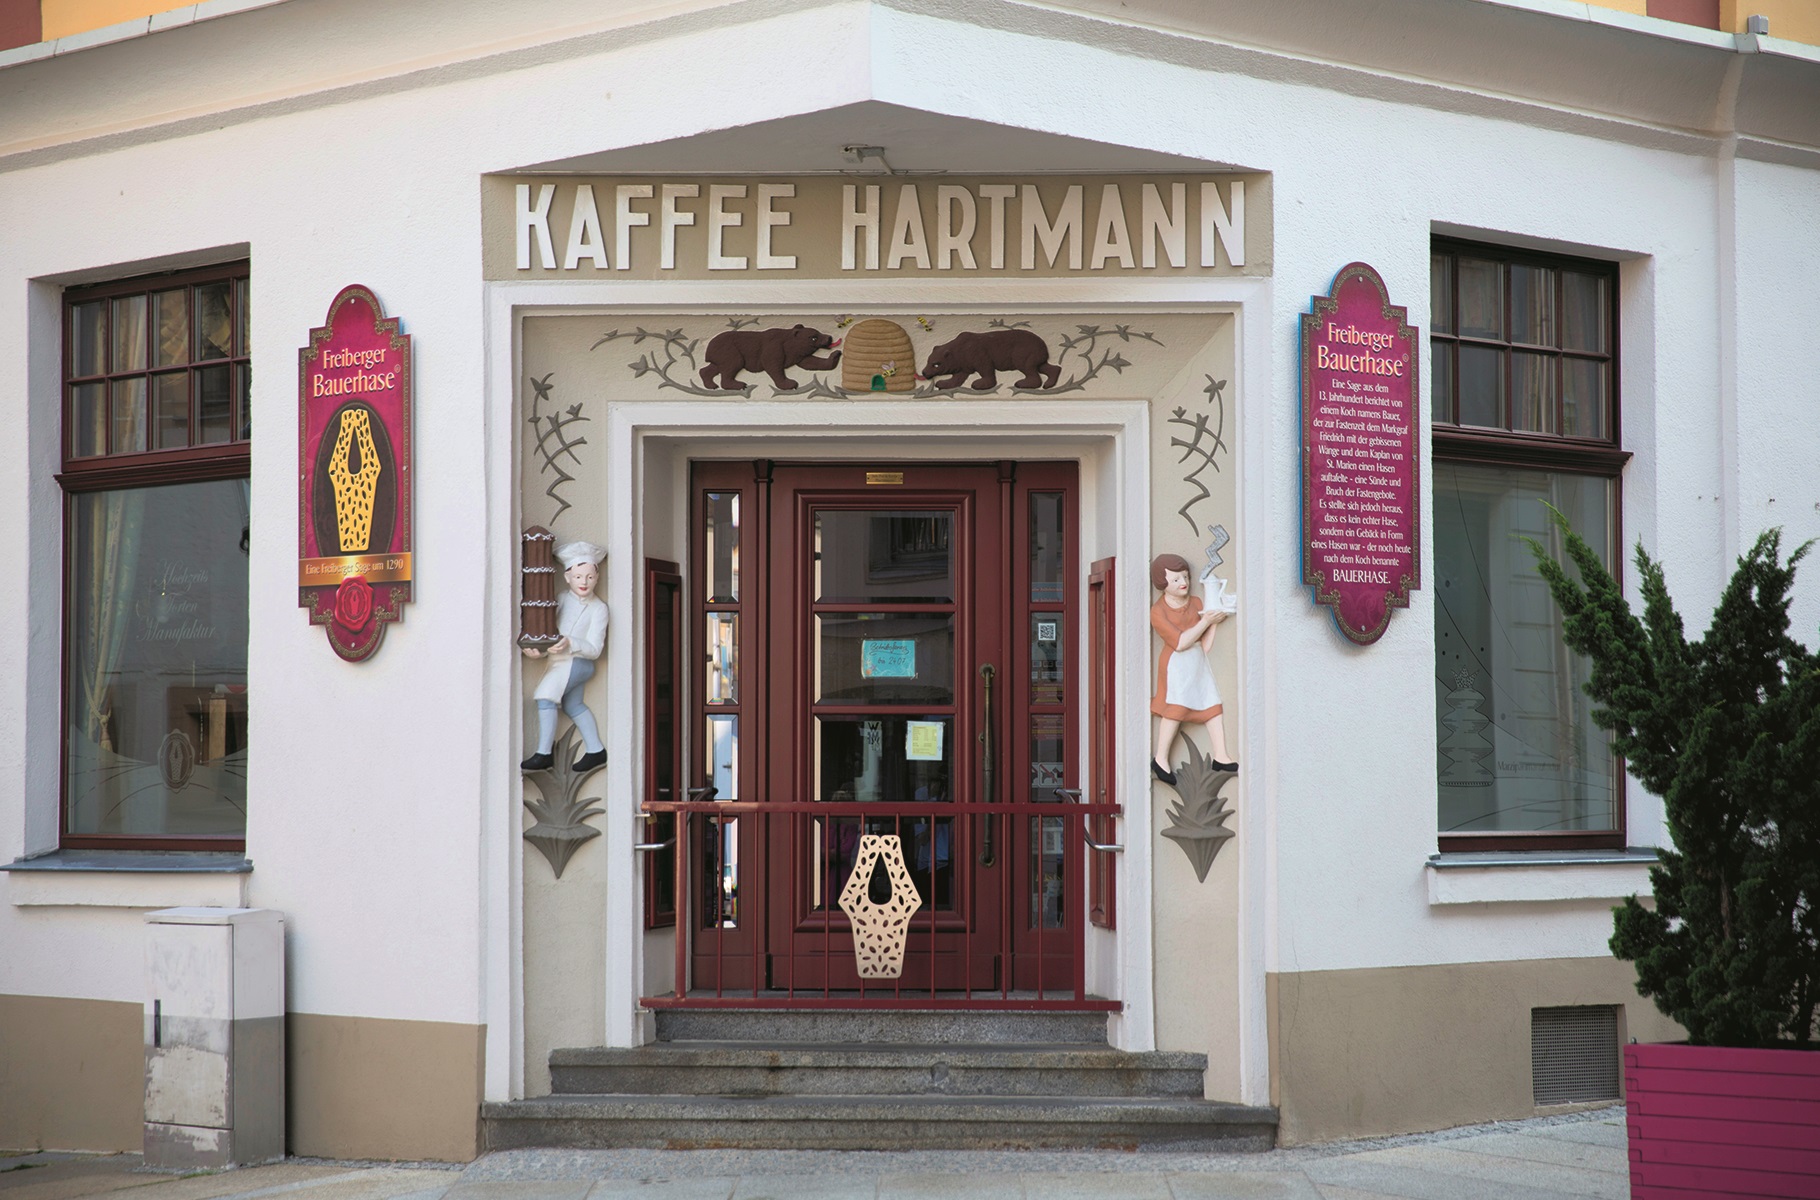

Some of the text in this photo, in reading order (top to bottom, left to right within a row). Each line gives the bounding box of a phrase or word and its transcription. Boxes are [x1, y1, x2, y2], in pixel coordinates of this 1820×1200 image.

[515, 181, 1246, 271] KAFFEE HARTMANN
[1328, 322, 1394, 352] Freiberger
[323, 348, 386, 370] Freiberger
[1332, 379, 1388, 393] Eine Sage aus dem
[1319, 391, 1402, 408] 13. Jahrhundert berichtet von
[1320, 406, 1401, 421] einem Koch namens Bauer,
[1313, 418, 1408, 436] der zur Fastenzeit dem Markgraf
[1320, 432, 1401, 447] Friedrich mit der gebissenen
[1318, 444, 1404, 461] Wange und dem Kaplan von
[1327, 459, 1395, 473] St. Marien einen Hasen
[1320, 473, 1348, 483] auftafelte
[1354, 475, 1367, 484] eine
[1369, 475, 1388, 486] Sünde
[1389, 477, 1401, 487] und
[1326, 486, 1396, 500] Bruch der Fastengebote.
[1320, 499, 1403, 514] Es stellte sich jedoch heraus,
[1324, 513, 1338, 523] dass
[1348, 514, 1360, 524] kein
[1362, 515, 1380, 525] echter
[1382, 517, 1398, 527] Hase,
[1319, 527, 1403, 540] sondern ein Gebäck in Form
[1311, 540, 1327, 549] eines
[1328, 540, 1348, 550] Hasen
[1349, 542, 1360, 551] war
[1367, 544, 1377, 552] der
[1378, 544, 1394, 553] noch
[1395, 544, 1411, 554] heute
[305, 559, 403, 575] Eine Freiberger Sage um 1290
[1324, 554, 1400, 566] nach dem Koch benannte
[1333, 568, 1391, 584] BAUERHASE.
